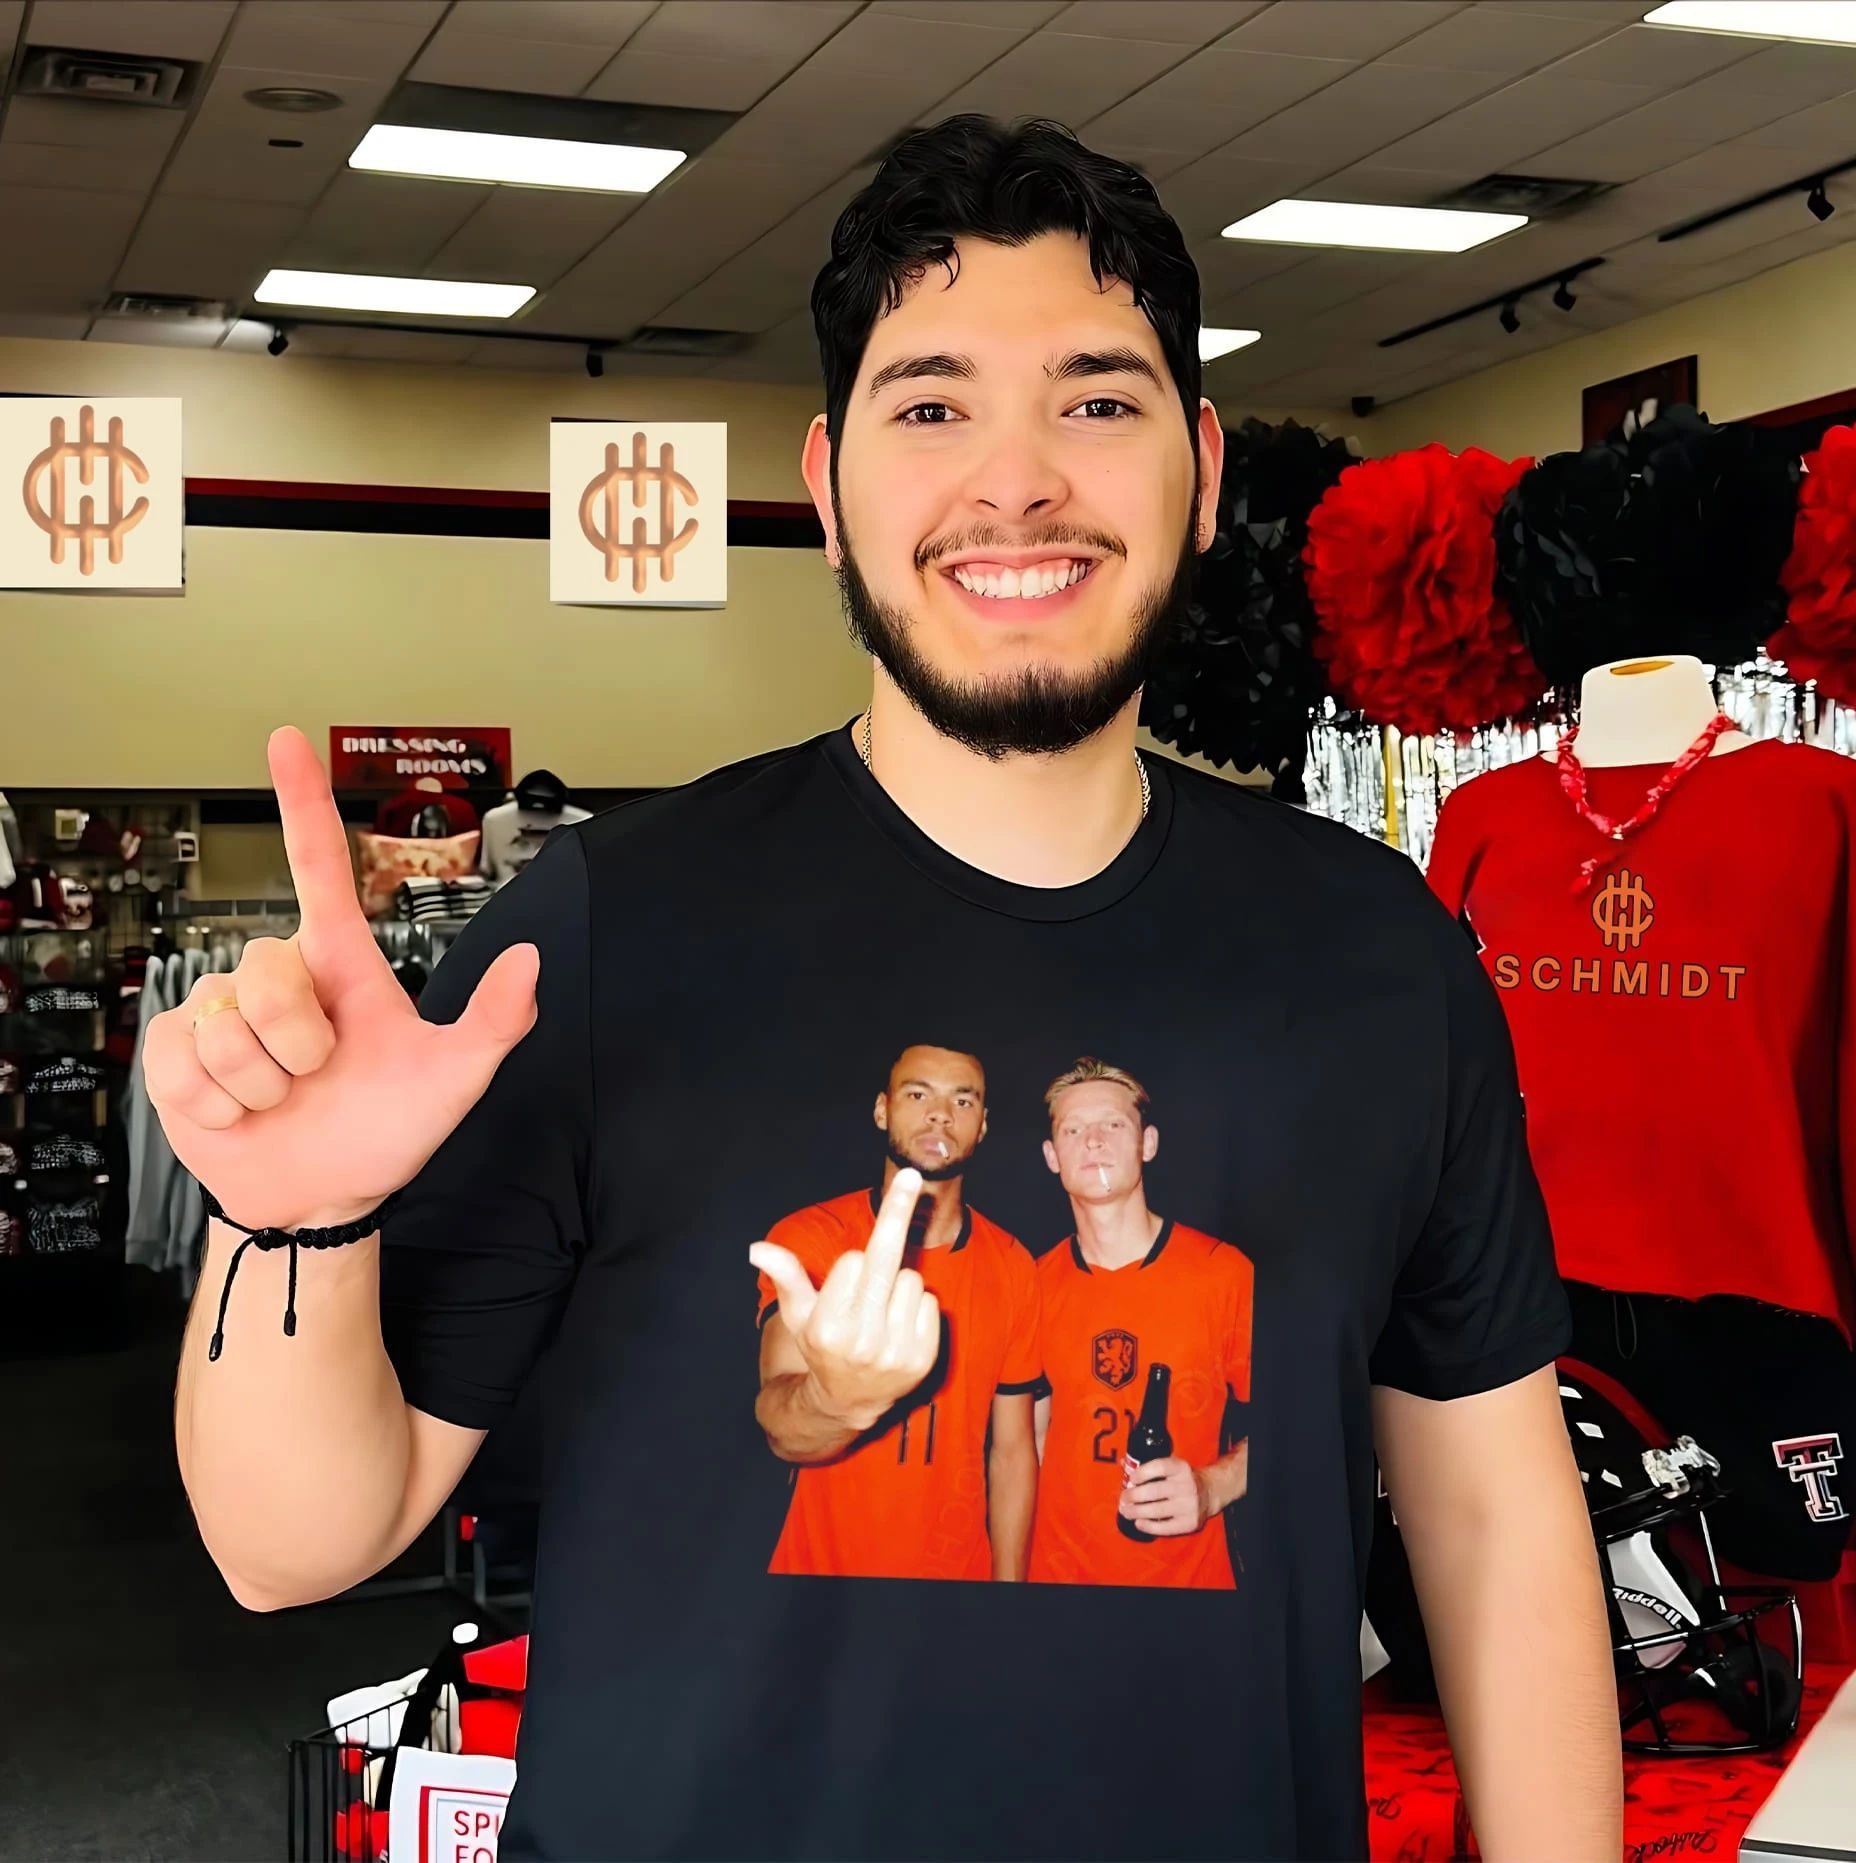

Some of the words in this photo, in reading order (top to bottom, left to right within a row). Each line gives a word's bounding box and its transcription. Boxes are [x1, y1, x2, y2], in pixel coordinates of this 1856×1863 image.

[341, 737, 467, 754] DRESSING
[396, 758, 487, 775] ROOMS
[1493, 953, 1746, 1000] SCHMIDT
